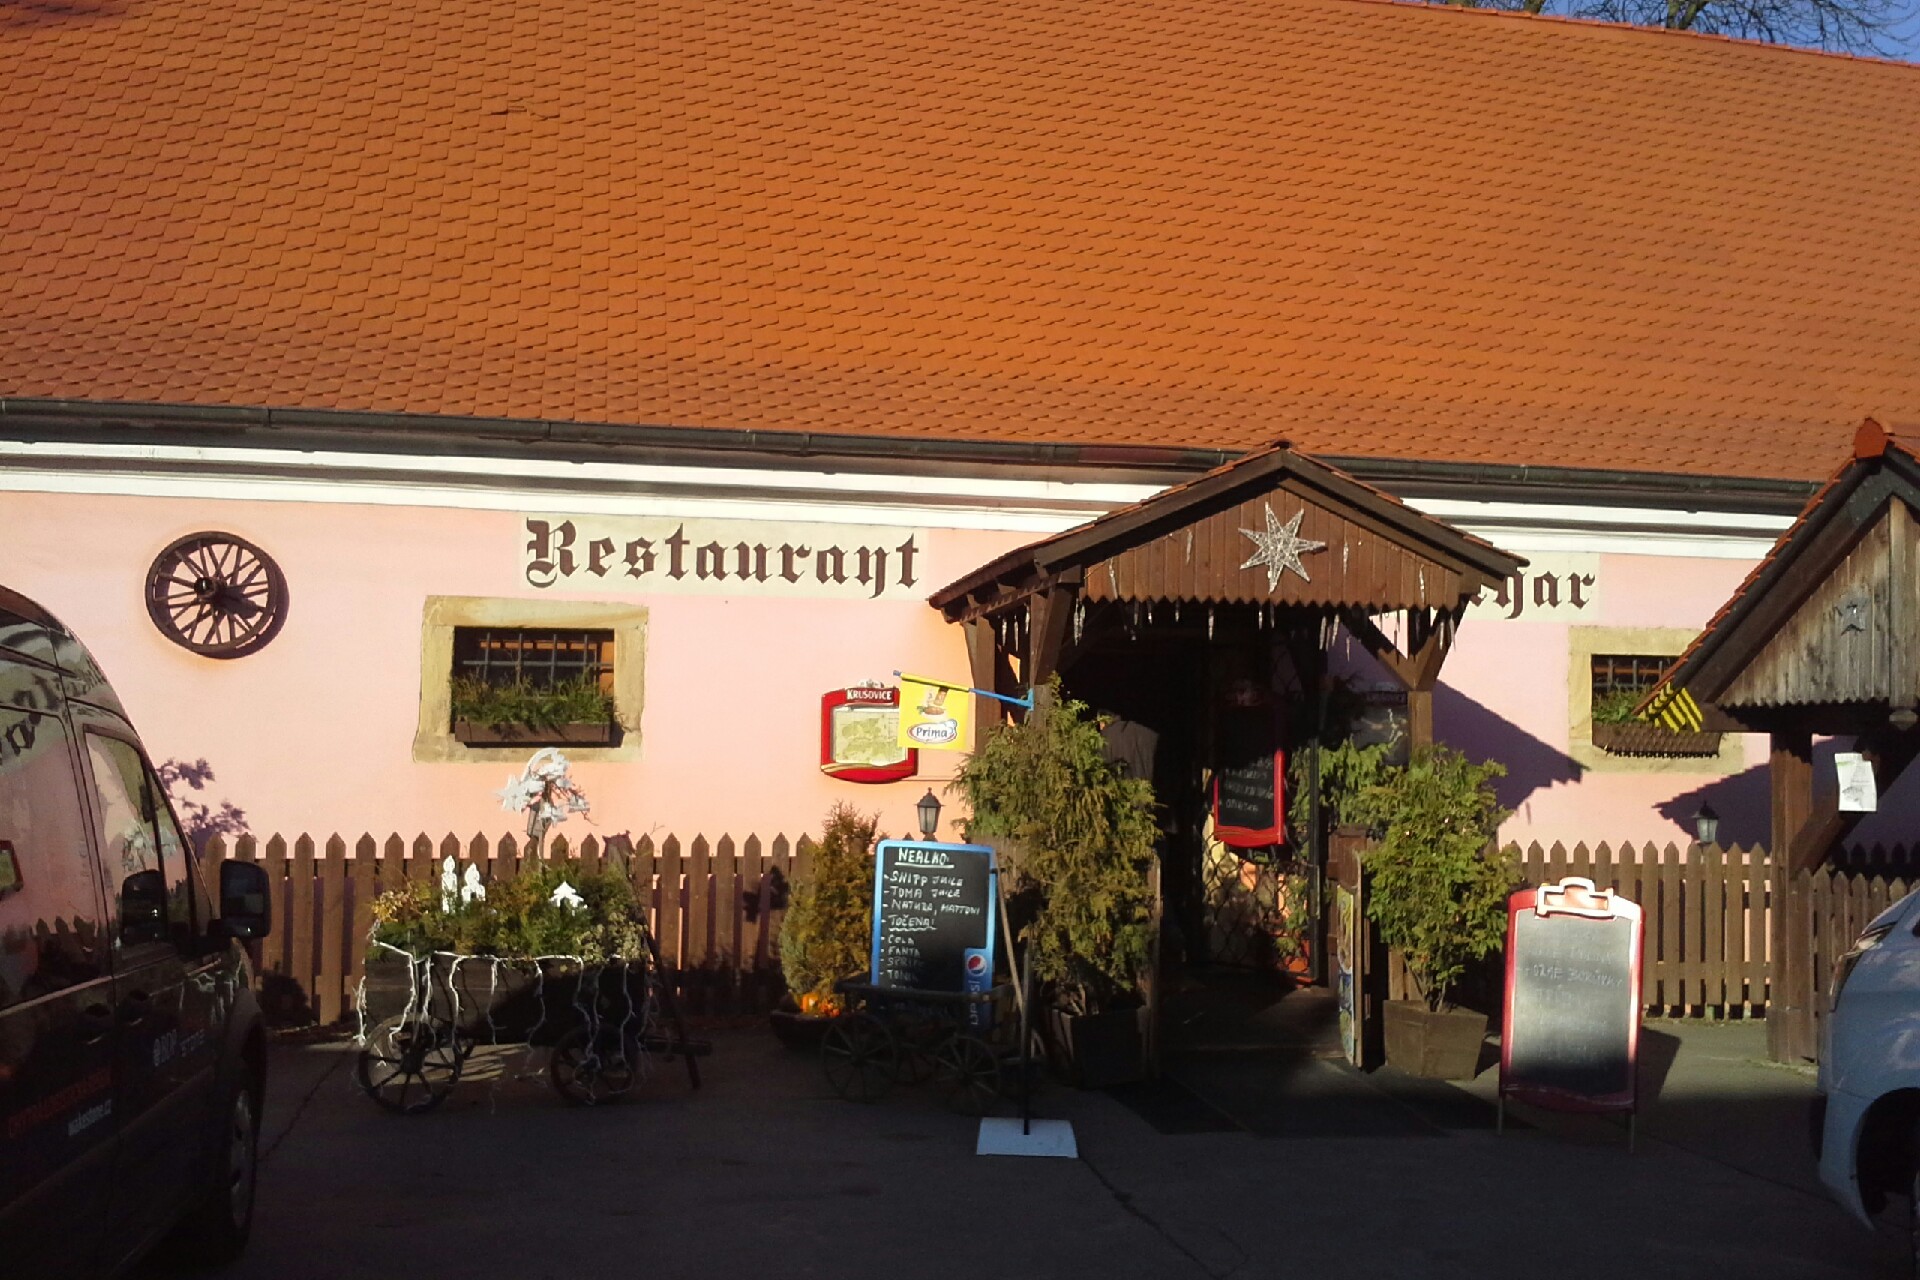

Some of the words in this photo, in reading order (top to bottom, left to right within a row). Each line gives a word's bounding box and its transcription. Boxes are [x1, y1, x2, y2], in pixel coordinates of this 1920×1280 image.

[526, 517, 919, 599] Restaurant
[916, 727, 948, 738] Prima
[890, 886, 922, 898] TOMA
[888, 946, 920, 956] FANTA
